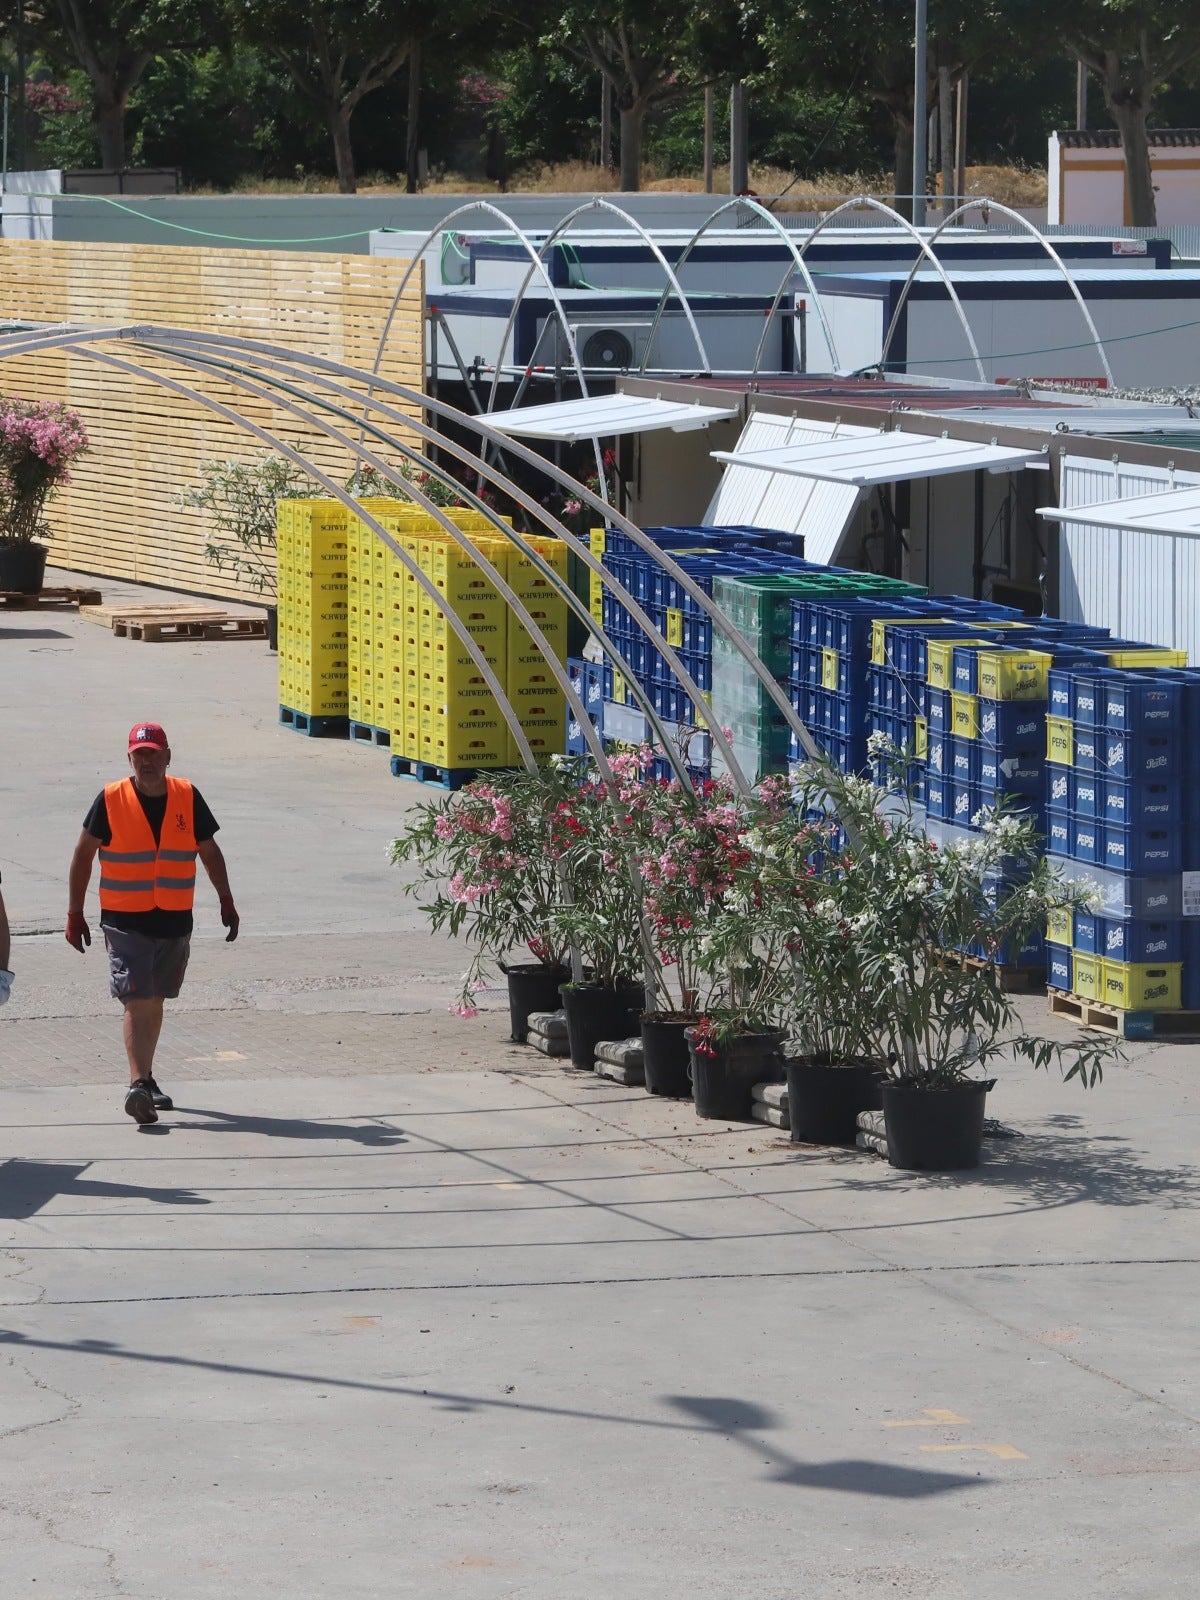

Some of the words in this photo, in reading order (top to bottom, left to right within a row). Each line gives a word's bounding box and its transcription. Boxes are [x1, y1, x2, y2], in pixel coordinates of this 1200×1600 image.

[320, 524, 347, 532] SCHWEP
[457, 593, 497, 601] SCHWEPPES
[518, 592, 558, 600] SCHWEPPES
[956, 667, 970, 681] PEPS
[982, 673, 996, 687] PEPS
[518, 687, 558, 695] SCHWEPPES
[1077, 696, 1094, 711] PEPSI
[1107, 702, 1125, 718] PEPSI
[931, 704, 943, 718] PEPS
[956, 711, 970, 725] PEPS
[1144, 711, 1170, 719] PEPSI
[458, 721, 497, 729] SCHWEPPES
[519, 719, 558, 727] SCHWEPPES
[1052, 737, 1067, 749] PEPS
[458, 753, 497, 761] SCHWEPPES
[954, 754, 968, 769] PEPS
[982, 764, 996, 778] PEPS
[929, 789, 942, 803] PEPS
[1077, 787, 1094, 801] PEPSI
[1107, 795, 1124, 809] PEPSI
[1144, 804, 1169, 813] PEPSI
[1052, 825, 1067, 841] PEPSI
[1077, 833, 1094, 849] PEPSI
[1107, 841, 1124, 857] PEPSI
[1144, 850, 1169, 859] PEPSI
[1052, 961, 1068, 978] PEPSI
